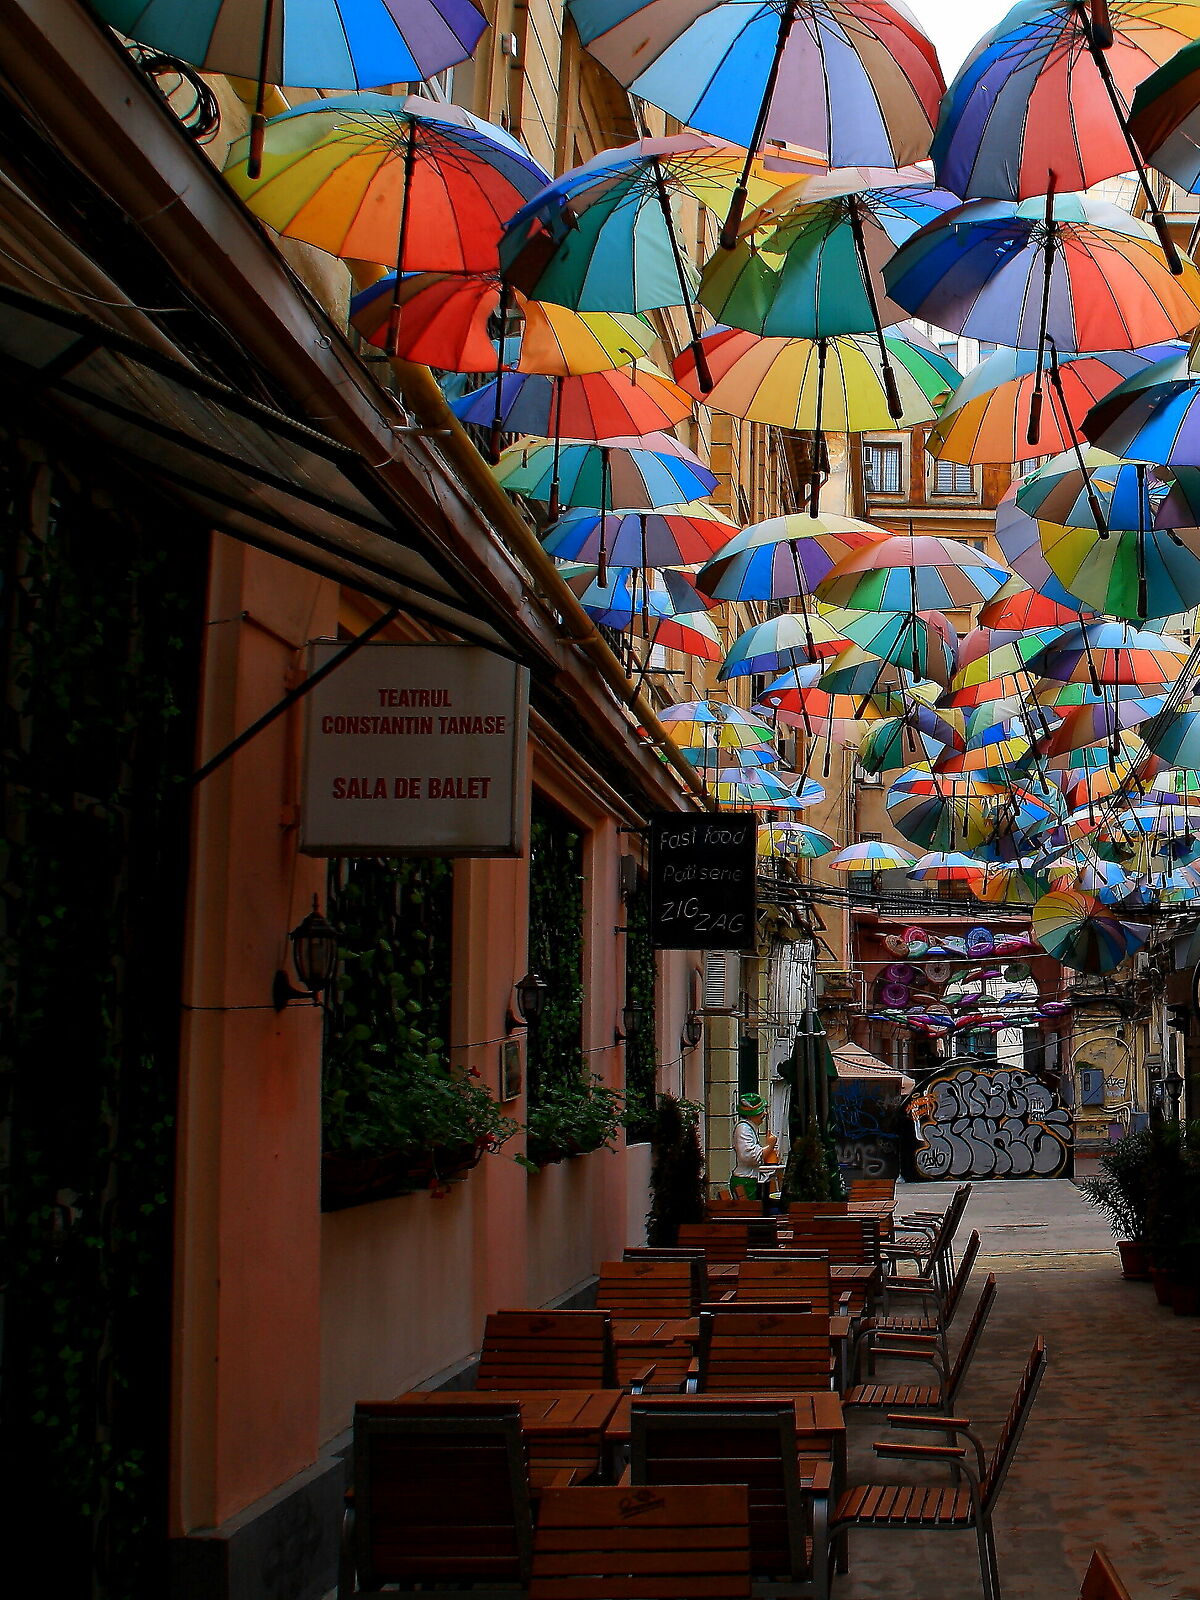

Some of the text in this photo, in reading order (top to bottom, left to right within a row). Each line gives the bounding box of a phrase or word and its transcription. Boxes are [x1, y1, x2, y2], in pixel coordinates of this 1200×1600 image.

[378, 688, 452, 707] TEATRUL
[322, 715, 506, 735] CONSTANTIN TANASE
[332, 777, 491, 799] SALA DE BALET
[660, 825, 697, 852] Fast
[660, 897, 745, 933] ZIG ZAG
